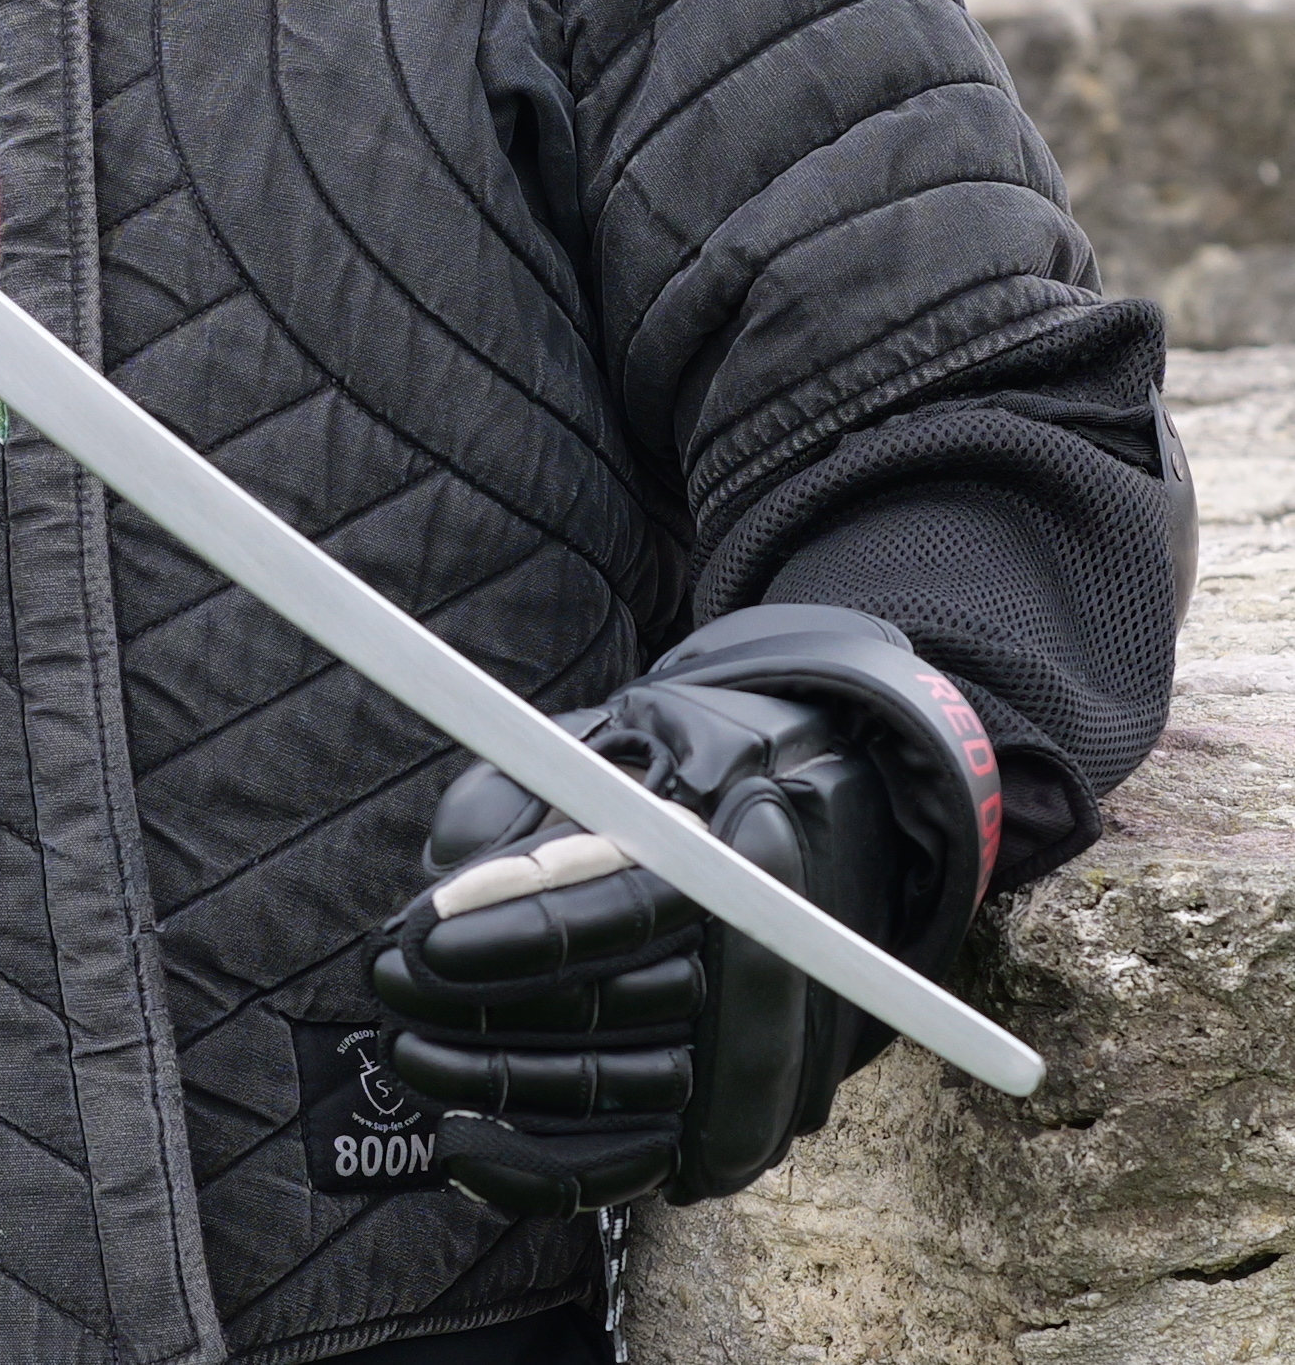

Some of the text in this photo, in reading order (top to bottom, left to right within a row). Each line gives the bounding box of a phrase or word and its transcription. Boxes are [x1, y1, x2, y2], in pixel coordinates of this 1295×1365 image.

[916, 673, 995, 776] RED
[336, 1030, 375, 1054] SUPERIOR
[334, 1134, 435, 1177] 800N
